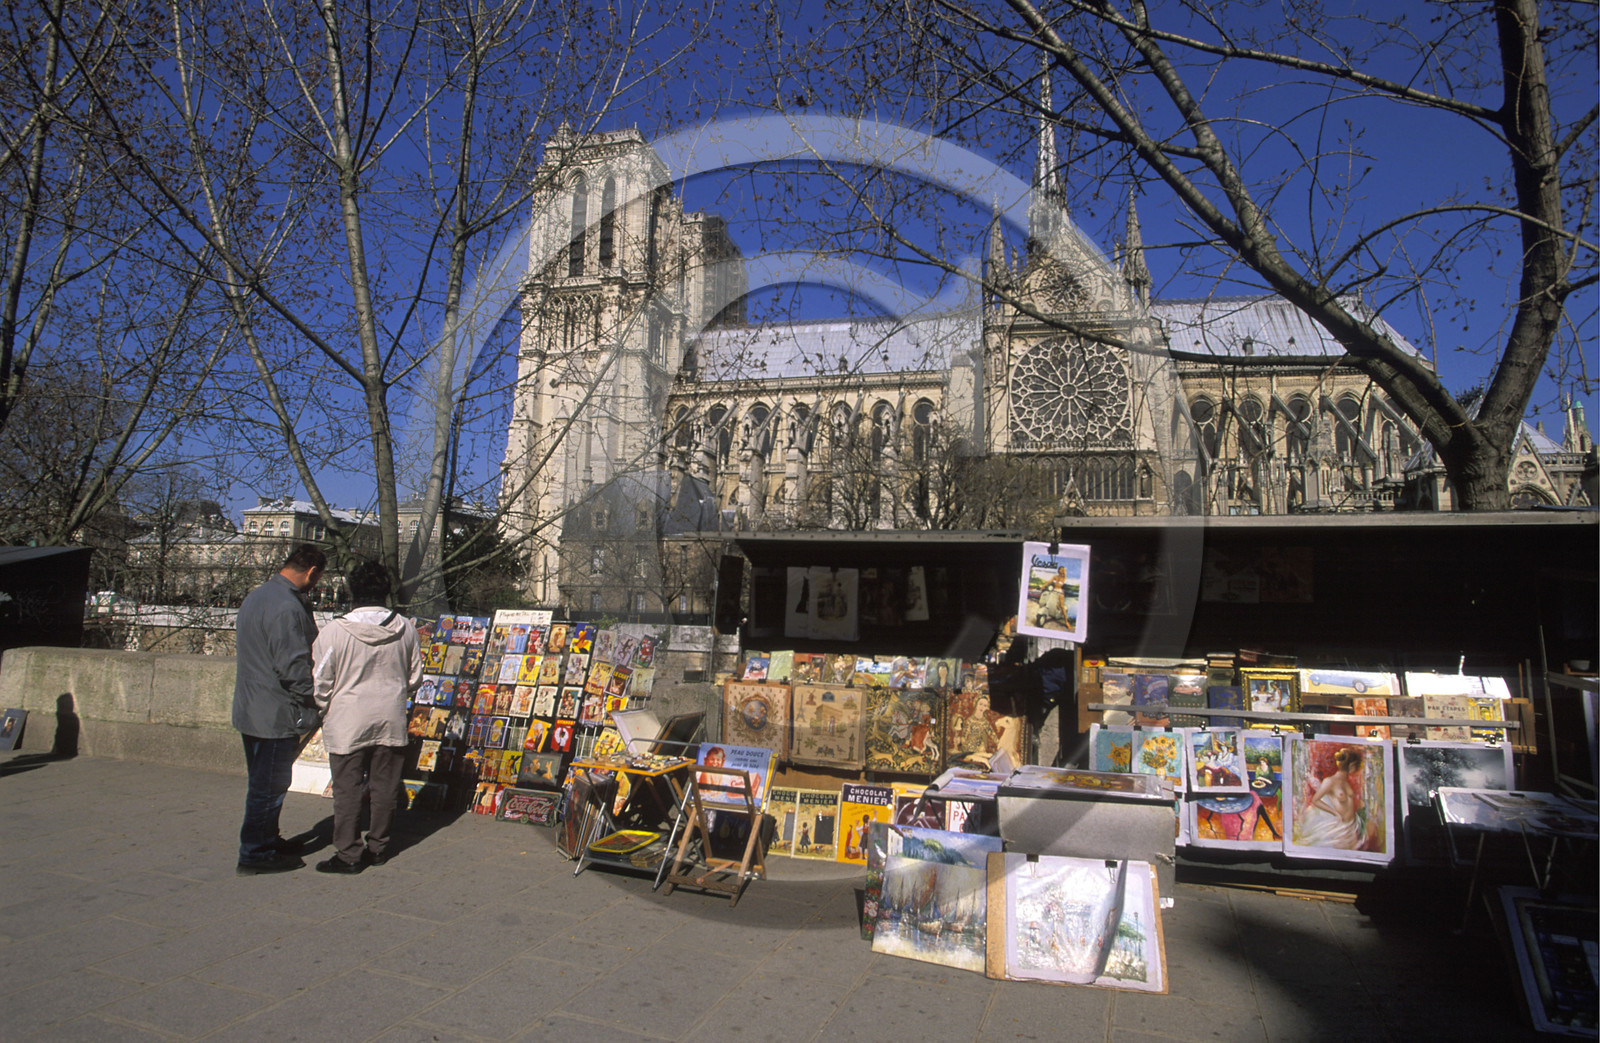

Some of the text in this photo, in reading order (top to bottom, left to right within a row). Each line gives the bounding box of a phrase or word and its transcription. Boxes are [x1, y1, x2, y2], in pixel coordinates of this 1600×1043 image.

[745, 750, 764, 758] DOUCE
[801, 792, 836, 800] CHOCOLAT
[850, 787, 887, 797] CHOCOLAT
[847, 794, 888, 806] MENIER
